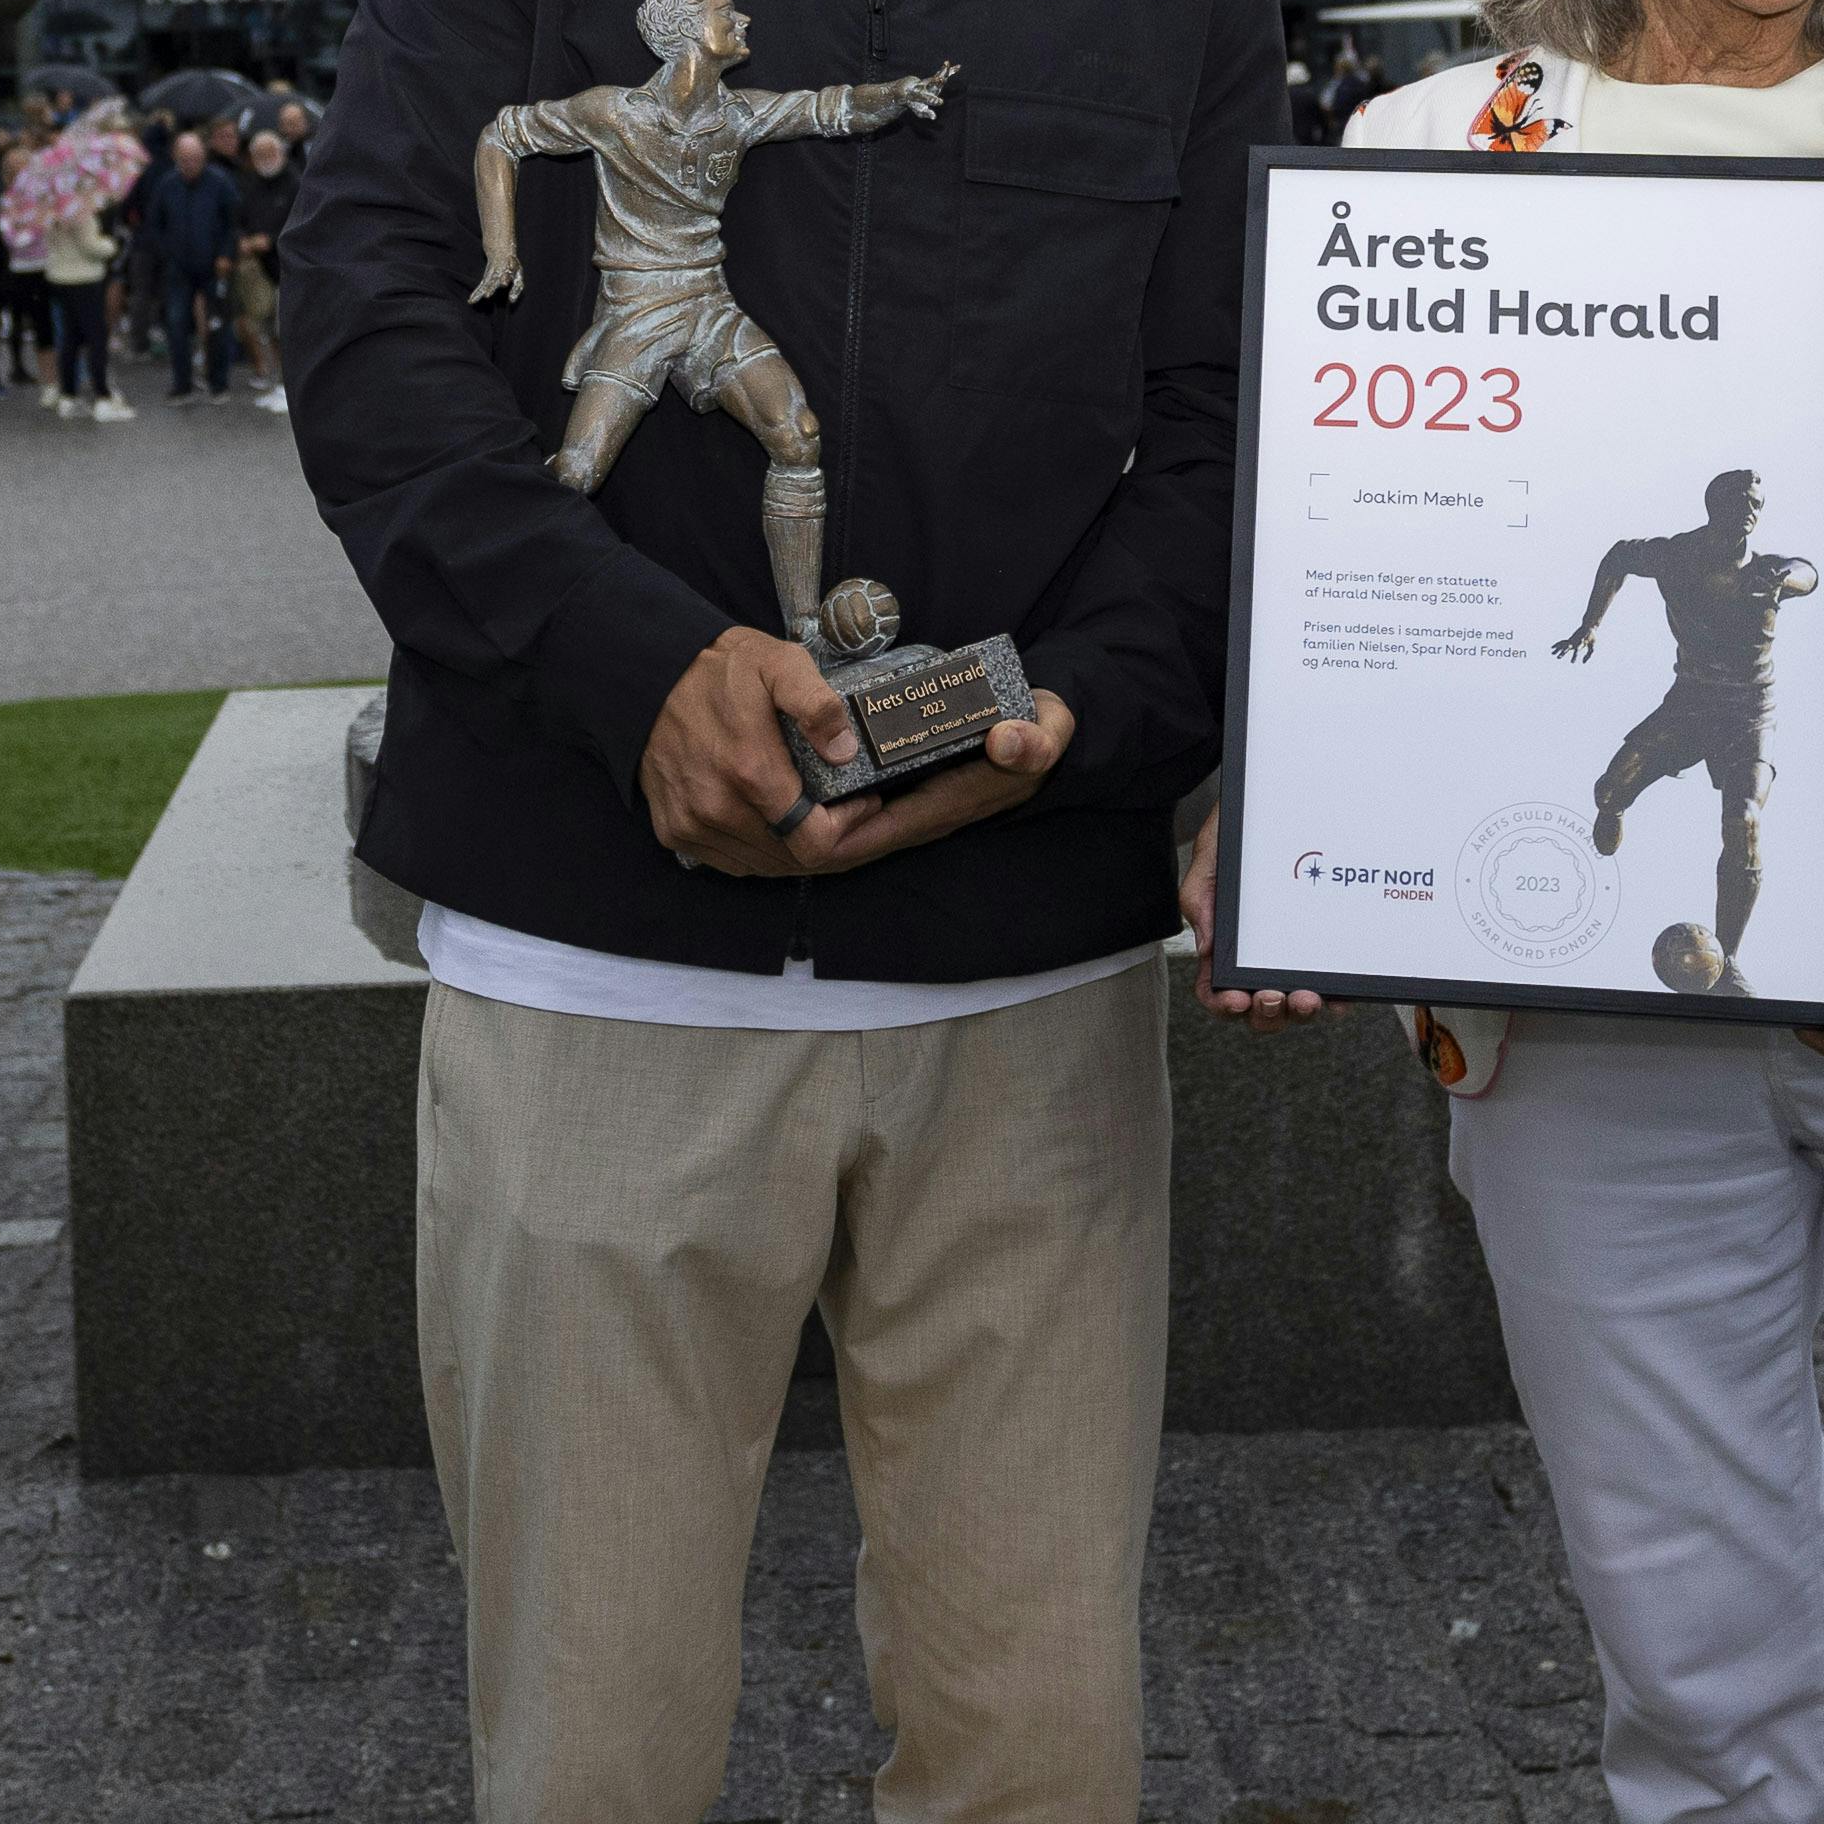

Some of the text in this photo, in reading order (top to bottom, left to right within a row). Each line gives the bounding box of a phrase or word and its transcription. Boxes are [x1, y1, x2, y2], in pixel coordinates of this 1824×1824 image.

[1316, 200, 1489, 270] Årets
[1316, 284, 1719, 341] Guld Harald
[1313, 362, 1523, 433] 2023
[1353, 489, 1484, 508] Joakim Mæhle
[1305, 569, 1498, 588] Med prisen følger en statuette
[1305, 587, 1503, 606] af Harald Nielsen og 25.000 kr.
[1304, 621, 1341, 633] Prisen
[1345, 623, 1395, 636] uddeles
[1405, 626, 1482, 642] samarbejde
[1486, 629, 1514, 640] med
[1303, 638, 1527, 659] familien Nielsen, Spar Nord Fonden
[1303, 656, 1398, 671] og Arena Nord.
[865, 661, 986, 716] Årets Guld Harald
[919, 699, 947, 718] 2023
[930, 717, 965, 735] Christian
[1470, 817, 1510, 853] ÅRETS
[1512, 810, 1553, 823] GULD
[1331, 866, 1380, 887] spar
[1515, 876, 1561, 893] 2023
[1383, 889, 1434, 902] FONDEN
[1471, 911, 1603, 960] SPAR NORD FONDEN
